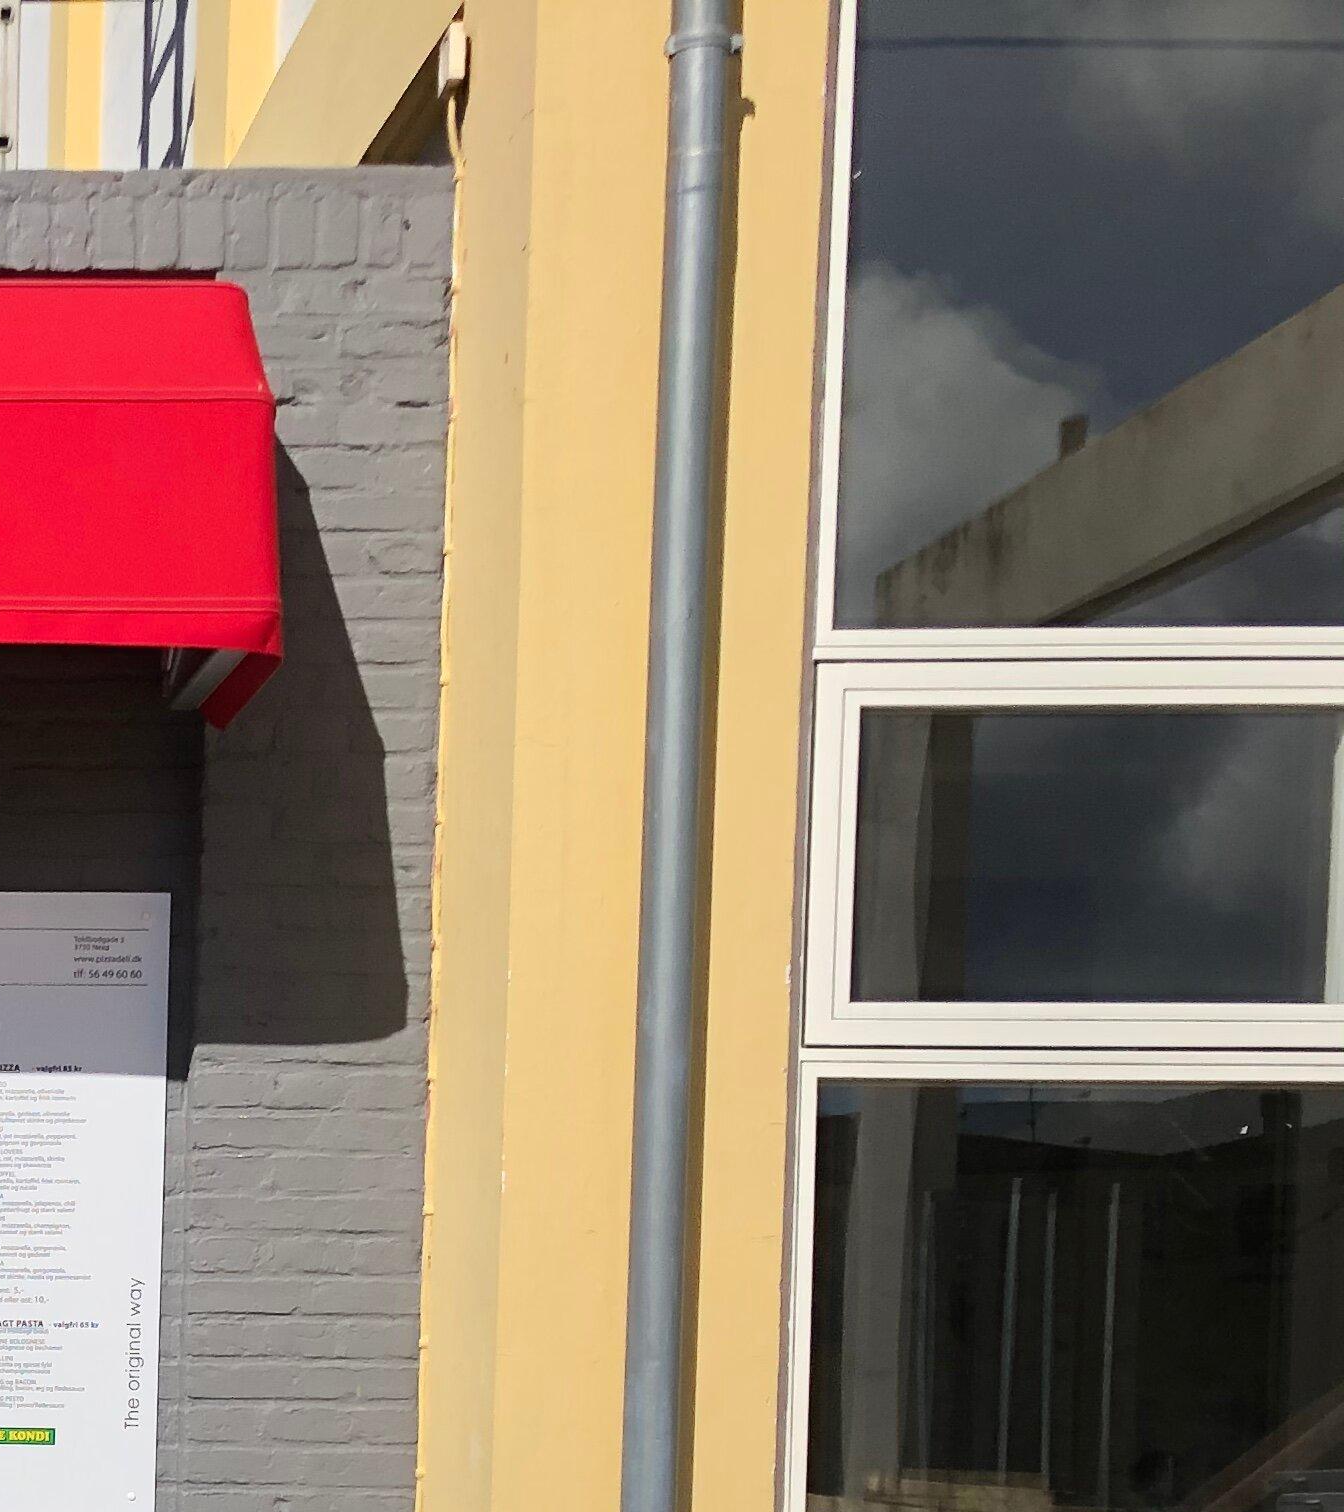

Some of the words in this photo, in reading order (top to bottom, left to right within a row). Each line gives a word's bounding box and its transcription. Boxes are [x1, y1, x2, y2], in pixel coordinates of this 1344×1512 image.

[89, 969, 100, 978] 56
[102, 969, 114, 978] 49
[116, 969, 128, 978] 60
[131, 1278, 145, 1317] way
[16, 1320, 43, 1328] PASTA
[53, 1322, 78, 1330] valgfri
[125, 1323, 144, 1391] original
[125, 1398, 140, 1429] The
[9, 1431, 50, 1442] KONDI
